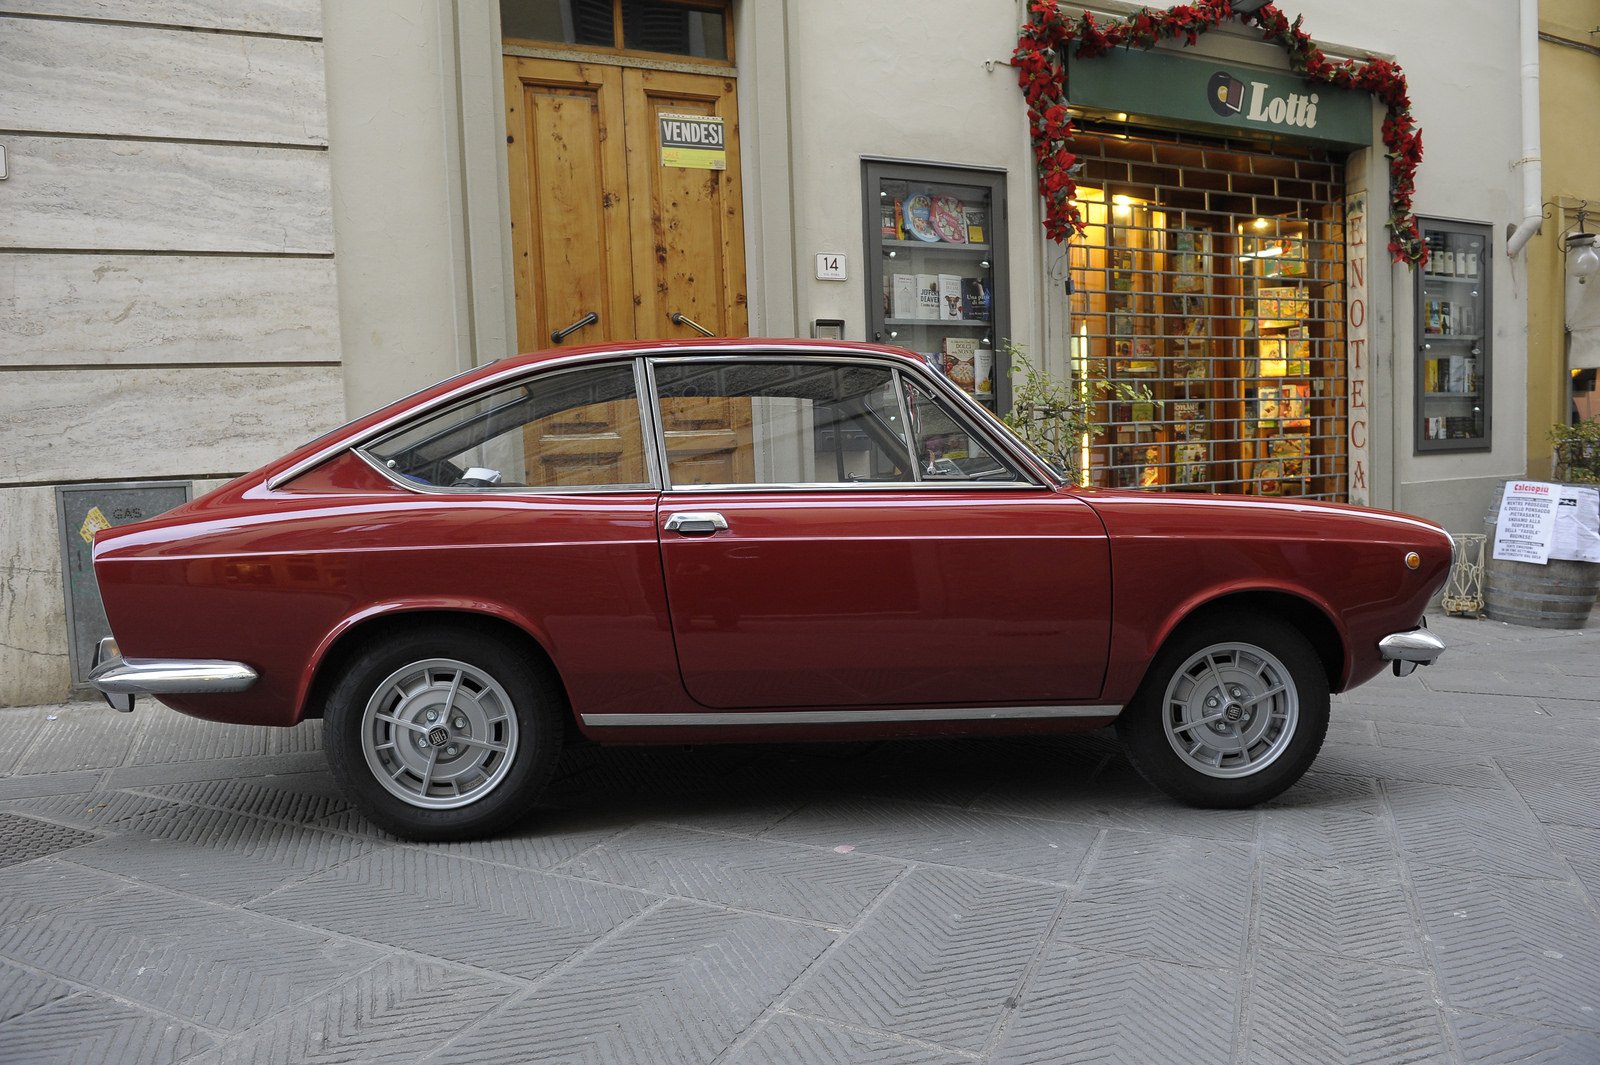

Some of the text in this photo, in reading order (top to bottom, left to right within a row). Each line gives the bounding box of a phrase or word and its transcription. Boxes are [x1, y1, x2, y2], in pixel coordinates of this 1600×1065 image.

[1247, 81, 1319, 129] Lotti
[662, 120, 723, 145] VENDESI
[824, 257, 839, 271] 14
[1350, 216, 1366, 490] ENOTECA
[112, 508, 142, 520] GAS
[1228, 705, 1241, 720] FIAT
[430, 729, 447, 744] FIAT
